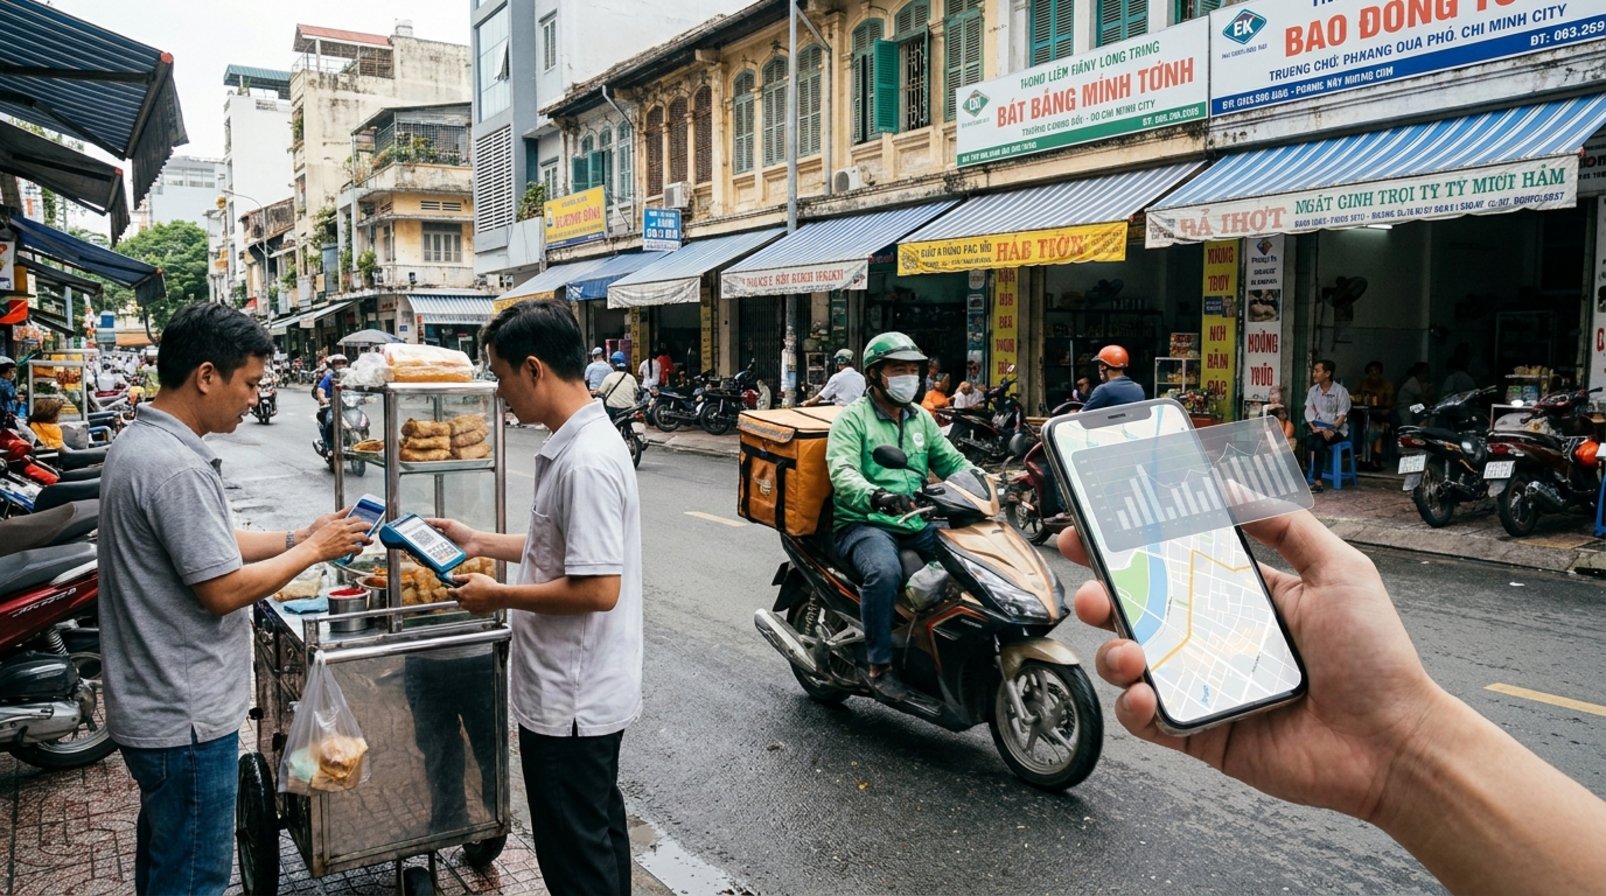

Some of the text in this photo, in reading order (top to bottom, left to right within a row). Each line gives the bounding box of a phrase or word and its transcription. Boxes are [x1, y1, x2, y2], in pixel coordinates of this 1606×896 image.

[1233, 19, 1254, 37] EK
[1461, 22, 1485, 39] CHI
[1489, 12, 1527, 33] MINH
[1532, 3, 1568, 23] CITY
[1285, 14, 1348, 57] BAO
[1137, 99, 1156, 112] CITY
